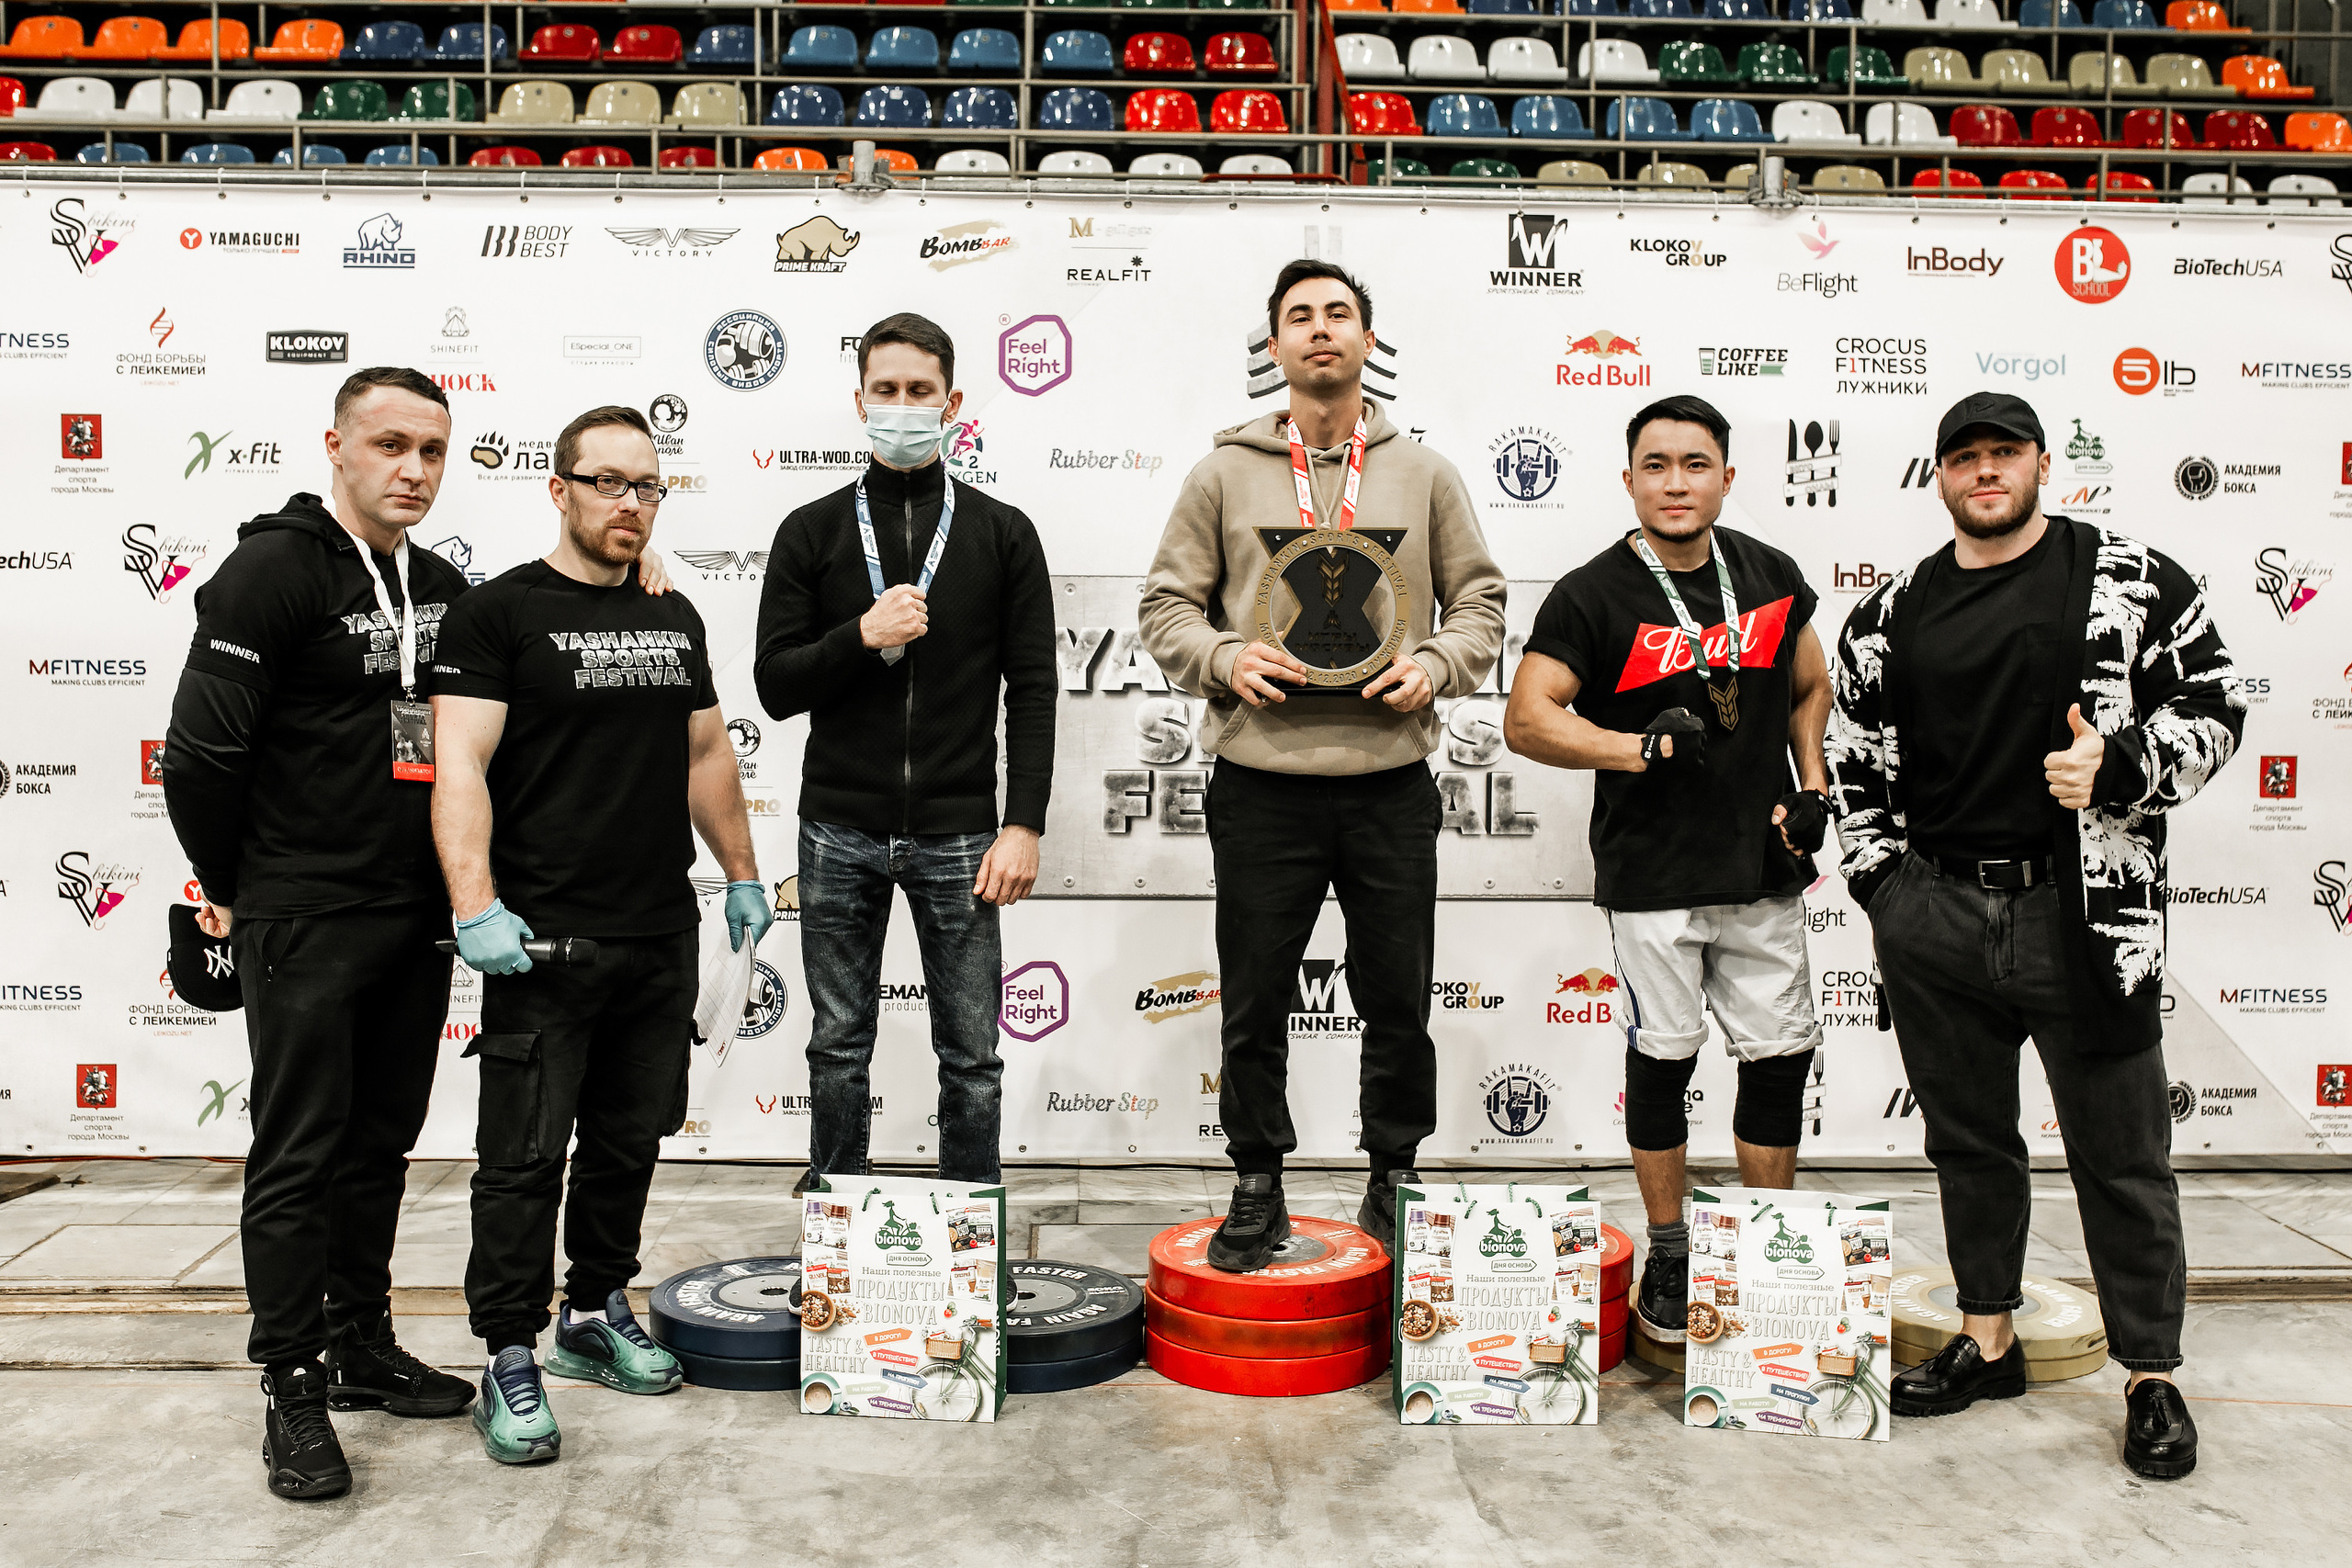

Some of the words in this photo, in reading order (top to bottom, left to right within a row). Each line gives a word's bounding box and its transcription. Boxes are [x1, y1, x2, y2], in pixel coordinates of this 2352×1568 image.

[87, 211, 138, 228] bikini
[210, 231, 300, 246] YAMAGUCHI
[525, 226, 572, 240] BODY
[520, 243, 569, 257] BEST
[1630, 239, 1702, 252] KLOKOV
[343, 253, 415, 264] RHINO
[1666, 254, 1726, 267] GROUP
[1907, 246, 2004, 276] InBody
[775, 261, 808, 273] PRIME
[810, 261, 846, 273] KRAFT
[2174, 258, 2283, 276] BioTechUSA
[1068, 269, 1151, 281] REALFIT
[1490, 271, 1582, 288] WINNER
[1777, 272, 1859, 298] BeFlight
[2073, 283, 2112, 297] SCHOOL
[269, 336, 345, 351] KLOKOV
[430, 344, 479, 354] SHINEFIT
[1008, 338, 1047, 354] Feel
[1836, 337, 1927, 355] CROCUS
[117, 354, 151, 365] ФОНД
[155, 354, 206, 364] БОРЬБЫ
[1718, 348, 1788, 362] COFFEE
[1007, 358, 1060, 378] Right
[1717, 363, 1758, 376] LIKE
[1975, 352, 2066, 380] Vorgol
[2242, 363, 2352, 378] MFITNESS
[1556, 364, 1601, 386] Red
[1607, 365, 1650, 386] Bull
[1837, 380, 1927, 394] ЛУЖНИКИ
[2065, 446, 2106, 457] bionova
[54, 465, 109, 474] Департамент
[1049, 448, 1119, 469] Rubber
[1122, 449, 1163, 478] Step
[2224, 464, 2281, 476] АКАДЕМИЯ
[81, 485, 114, 493] Москвы
[2223, 482, 2256, 494] БОКСА
[159, 535, 210, 553] bikini
[1257, 542, 1300, 606] YASHANKIN
[1309, 532, 1360, 546] SPORTS
[1370, 546, 1408, 599] FESTIVAL
[2289, 558, 2336, 577] bikini
[548, 630, 692, 651] YASHANKIN
[1368, 619, 1407, 671] ЛУЖНИКИ
[209, 638, 260, 664] WINNER
[580, 648, 680, 668] SPORTS
[29, 660, 146, 675] MFITNESS
[574, 667, 692, 689] FESTIVAL
[2312, 698, 2346, 709] ФОНД
[16, 764, 76, 777] АКАДЕМИЯ
[17, 783, 51, 795] БОКСА
[130, 810, 159, 818] города
[2253, 804, 2303, 812] Департамент
[92, 864, 143, 881] bikini
[1005, 985, 1044, 1000] Feel
[2221, 988, 2327, 1003] MFITNESS
[129, 1005, 164, 1016] ФОНД
[1442, 996, 1504, 1010] GROUP
[1005, 1003, 1057, 1023] Right
[1546, 1002, 1590, 1024] Red
[1479, 1063, 1555, 1090] RAKAMAKAFIT
[2200, 1088, 2257, 1100] АКАДЕМИЯ
[1046, 1091, 1115, 1112] Rubber
[1117, 1091, 1159, 1120] Step
[2200, 1105, 2233, 1116] БОКСА
[70, 1114, 124, 1122] Департамент
[97, 1133, 130, 1141] Москвы
[876, 1234, 922, 1247] bionova
[1480, 1240, 1527, 1253] bionova
[1765, 1245, 1814, 1259] bionova
[862, 1267, 890, 1277] Наши
[893, 1269, 941, 1278] полезные
[1012, 1266, 1089, 1280] FASTER
[1466, 1274, 1495, 1283] Наши
[1498, 1275, 1546, 1284] полезные
[855, 1279, 945, 1302] ПРОДУКТЫ
[1751, 1279, 1781, 1289] Наши
[1783, 1281, 1835, 1292] полезные
[1459, 1286, 1549, 1308] ПРОДУКТЫ
[1745, 1292, 1838, 1316] ПРОДУКТЫ
[863, 1302, 937, 1325] BIONOVA
[1466, 1310, 1542, 1331] BIONOVA
[1751, 1316, 1830, 1341] BIONOVA
[808, 1336, 851, 1354] TASTY
[1408, 1346, 1453, 1363] TASTY
[1692, 1348, 1737, 1367] TASTY
[805, 1354, 868, 1373] HEALTHY
[1406, 1363, 1471, 1381] HEALTHY
[1690, 1365, 1757, 1389] HEALTHY
